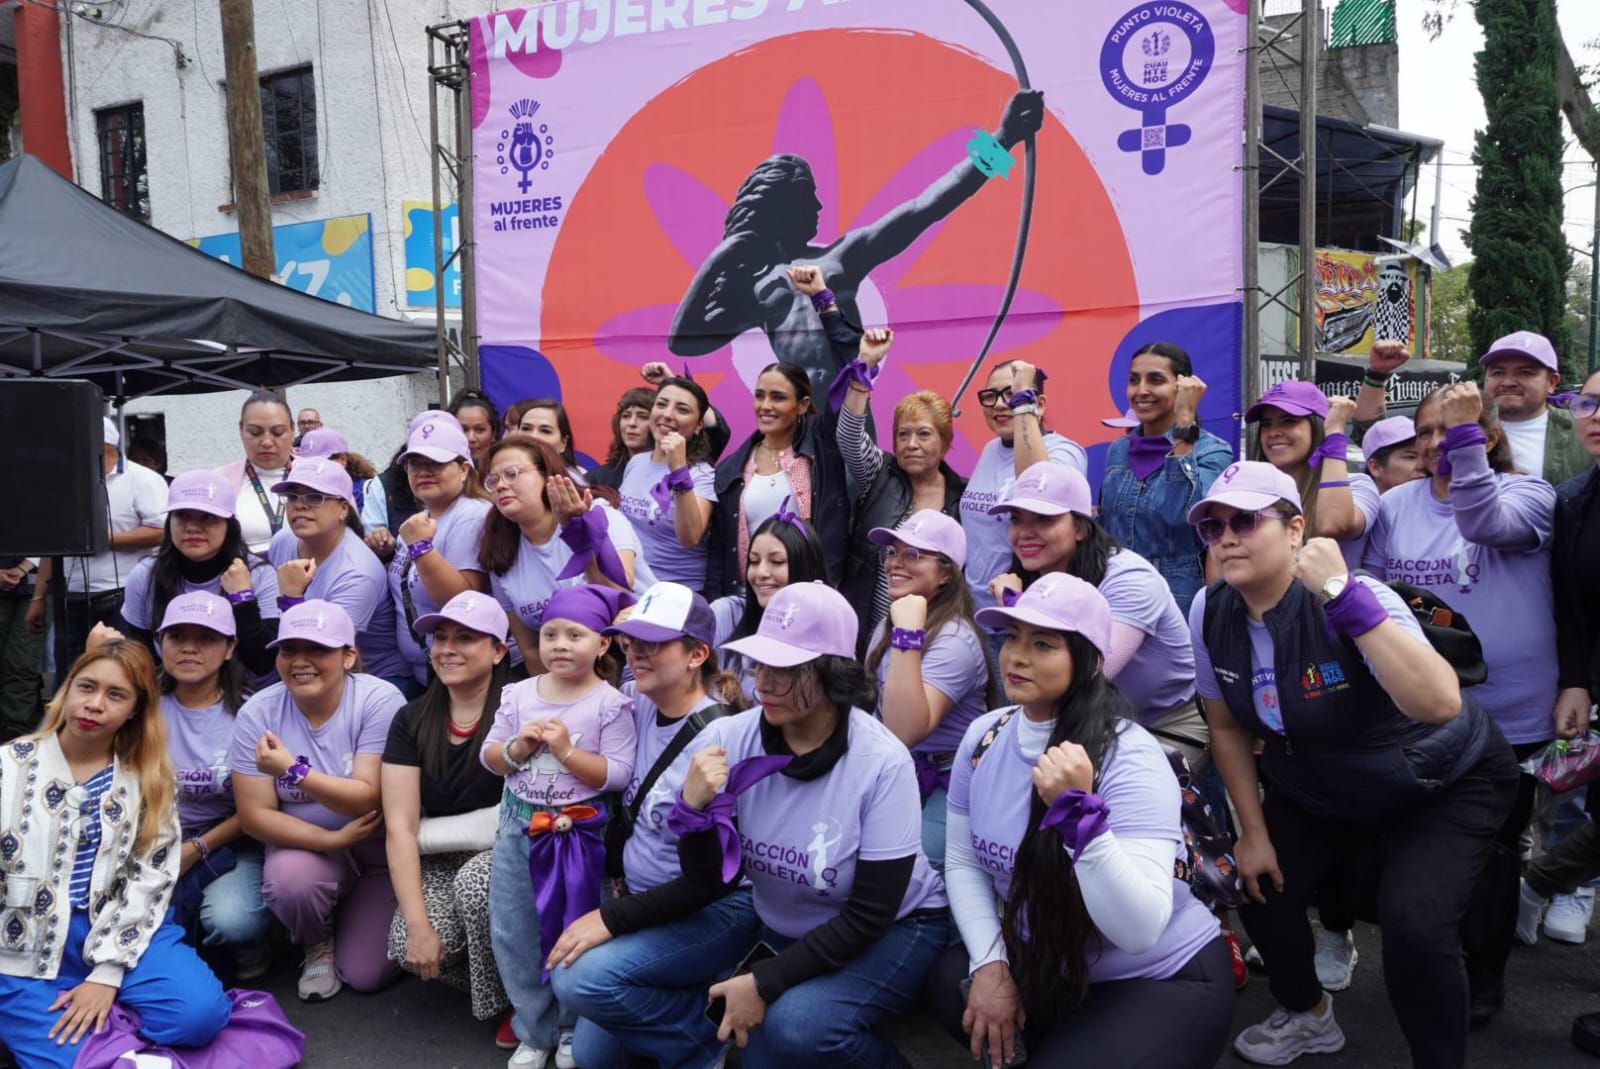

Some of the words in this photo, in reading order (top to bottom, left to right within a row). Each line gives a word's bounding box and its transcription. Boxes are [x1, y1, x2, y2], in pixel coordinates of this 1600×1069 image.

[1111, 9, 1151, 44] PUNTO
[1154, 6, 1204, 34] VIOLETA
[1144, 61, 1168, 69] CUAU
[1109, 68, 1148, 103] MUJERES
[1151, 92, 1167, 103] AL
[1169, 58, 1203, 97] FRENTE
[1144, 75, 1167, 84] MOC
[490, 196, 562, 216] MUJERES
[494, 217, 507, 231] al
[510, 214, 558, 230] frente
[962, 490, 998, 502] EACCIÓN
[961, 502, 993, 512] VIOLET
[514, 780, 575, 805] Purrfect
[740, 832, 809, 869] EACCIÓN
